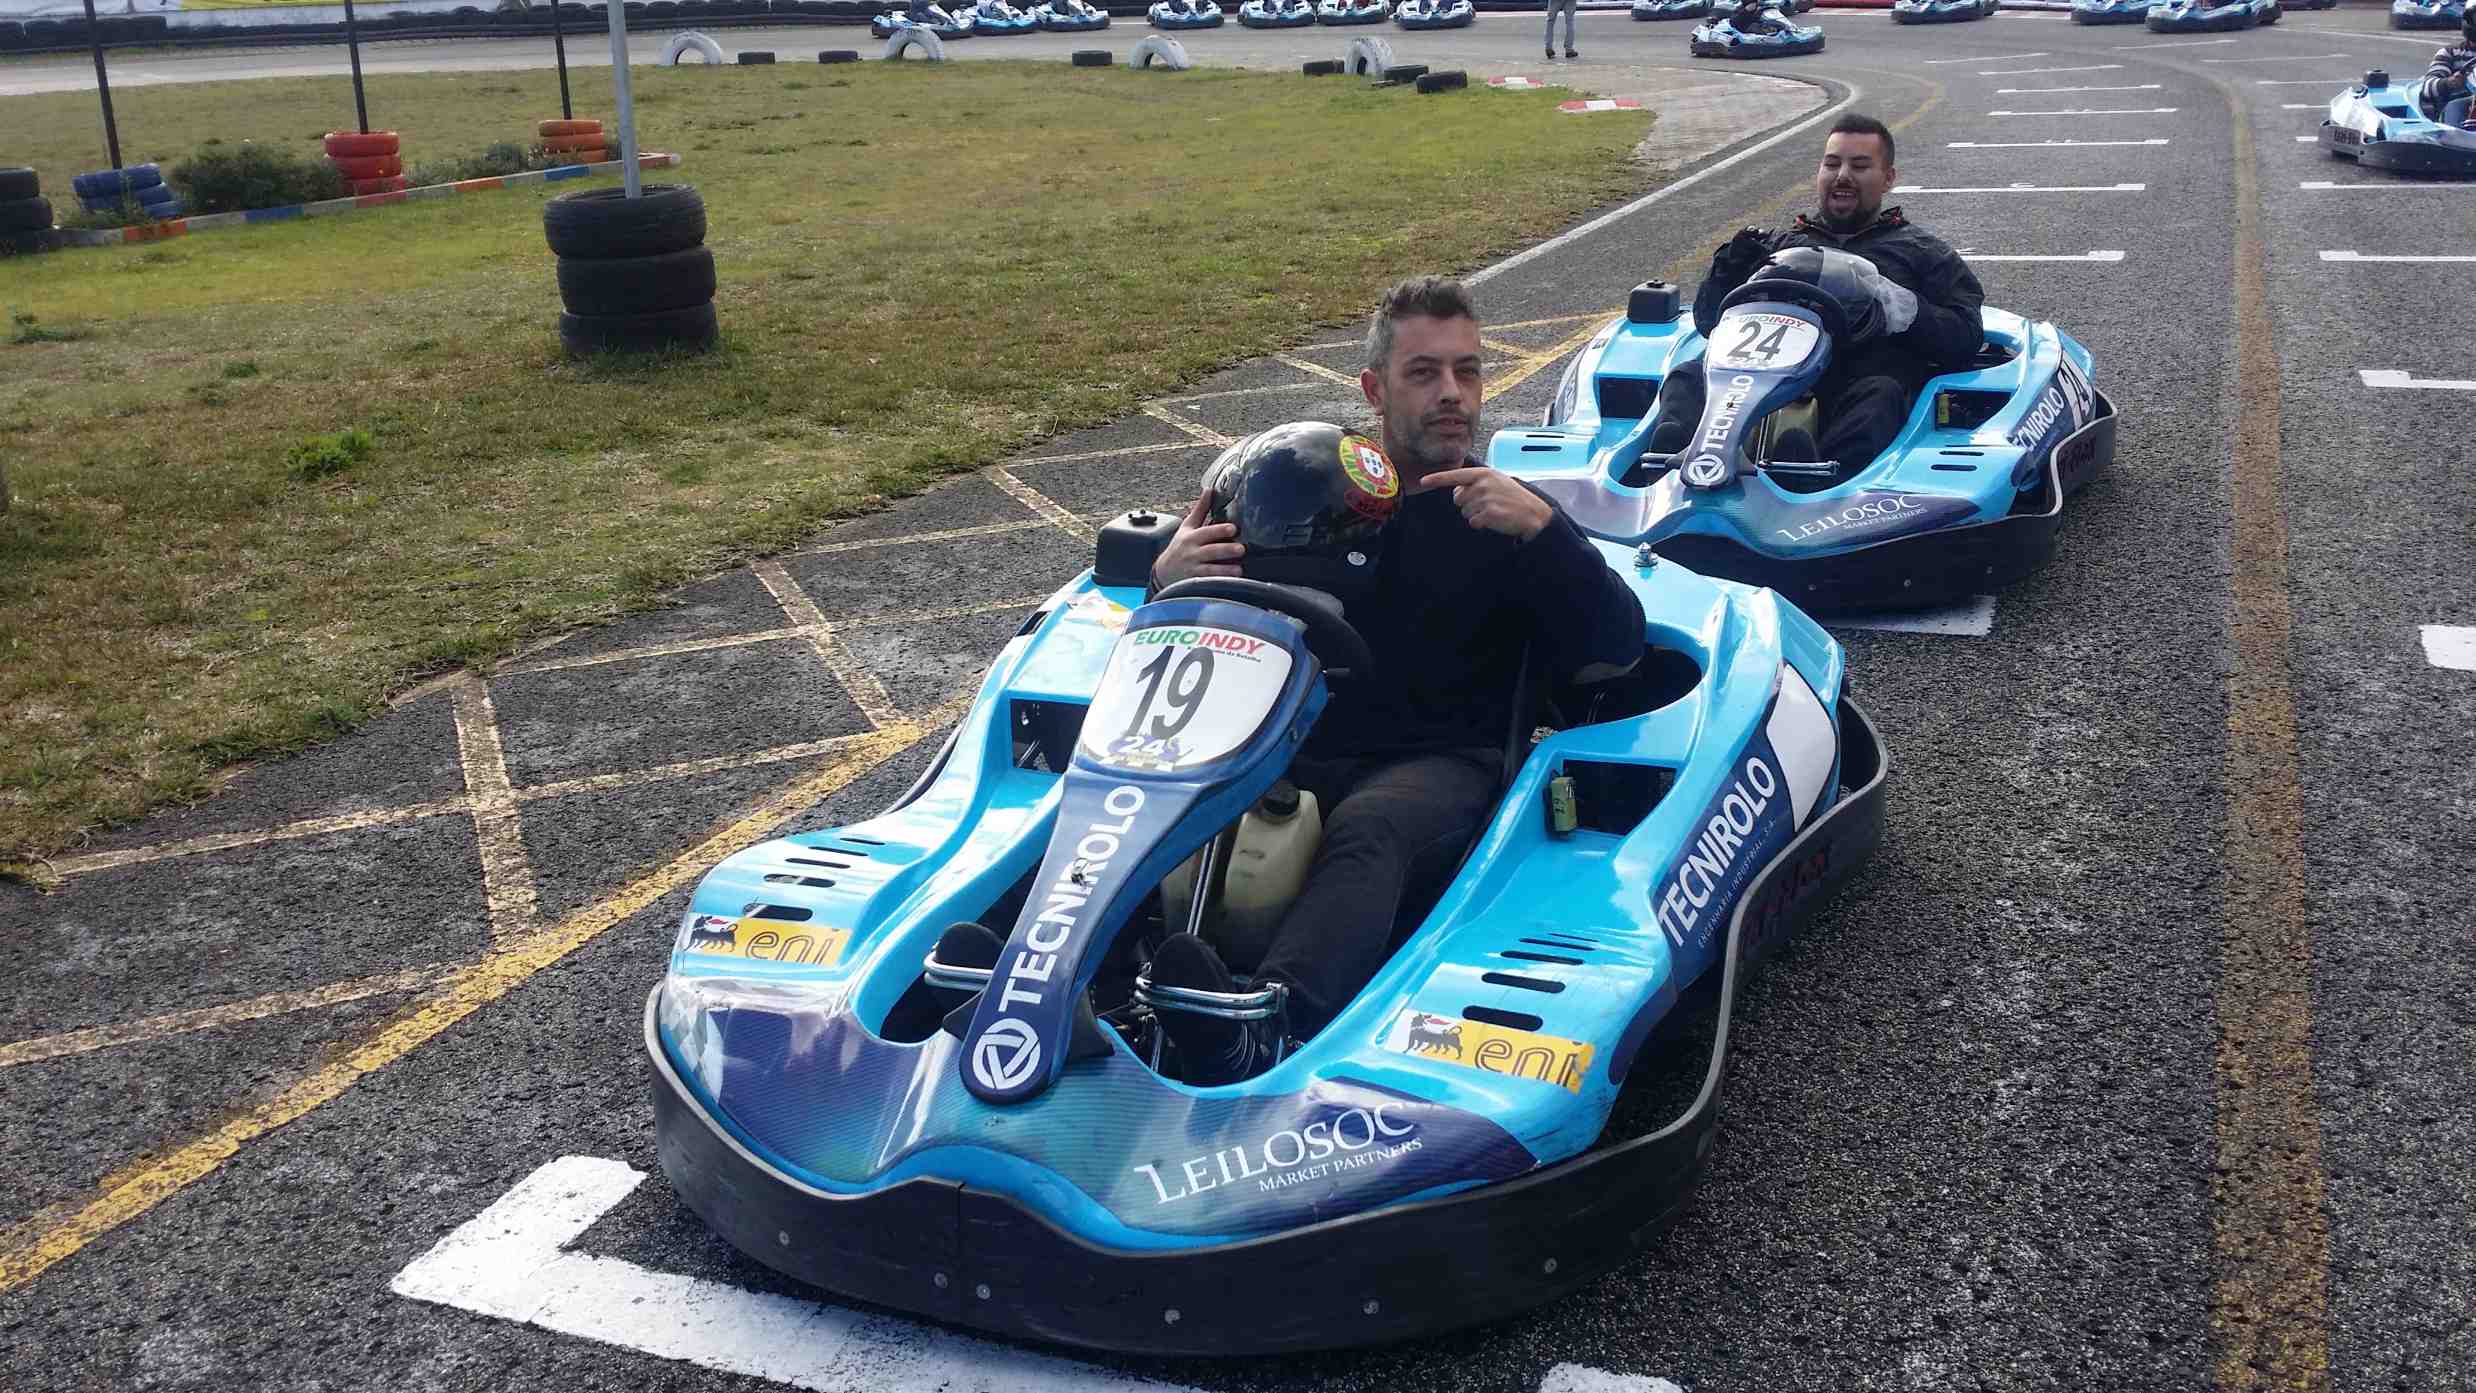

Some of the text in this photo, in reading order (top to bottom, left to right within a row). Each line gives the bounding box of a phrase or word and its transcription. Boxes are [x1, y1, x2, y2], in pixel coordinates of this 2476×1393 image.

[1727, 320, 1790, 361] 24
[1700, 375, 1754, 452] TECNIROLO
[2010, 387, 2064, 452] ECNIROLO
[1776, 494, 1921, 542] LEILOSOC
[1134, 630, 1265, 655] EUROINDY
[1127, 645, 1215, 740] 19
[1656, 756, 1776, 947] TECNIROLO
[998, 785, 1145, 1013] TECNIROLO
[745, 927, 841, 966] eni
[1474, 1036, 1584, 1087] eni
[1133, 1102, 1417, 1205] LEILOSOC
[1258, 1137, 1424, 1193] MARKET PARTNERS
